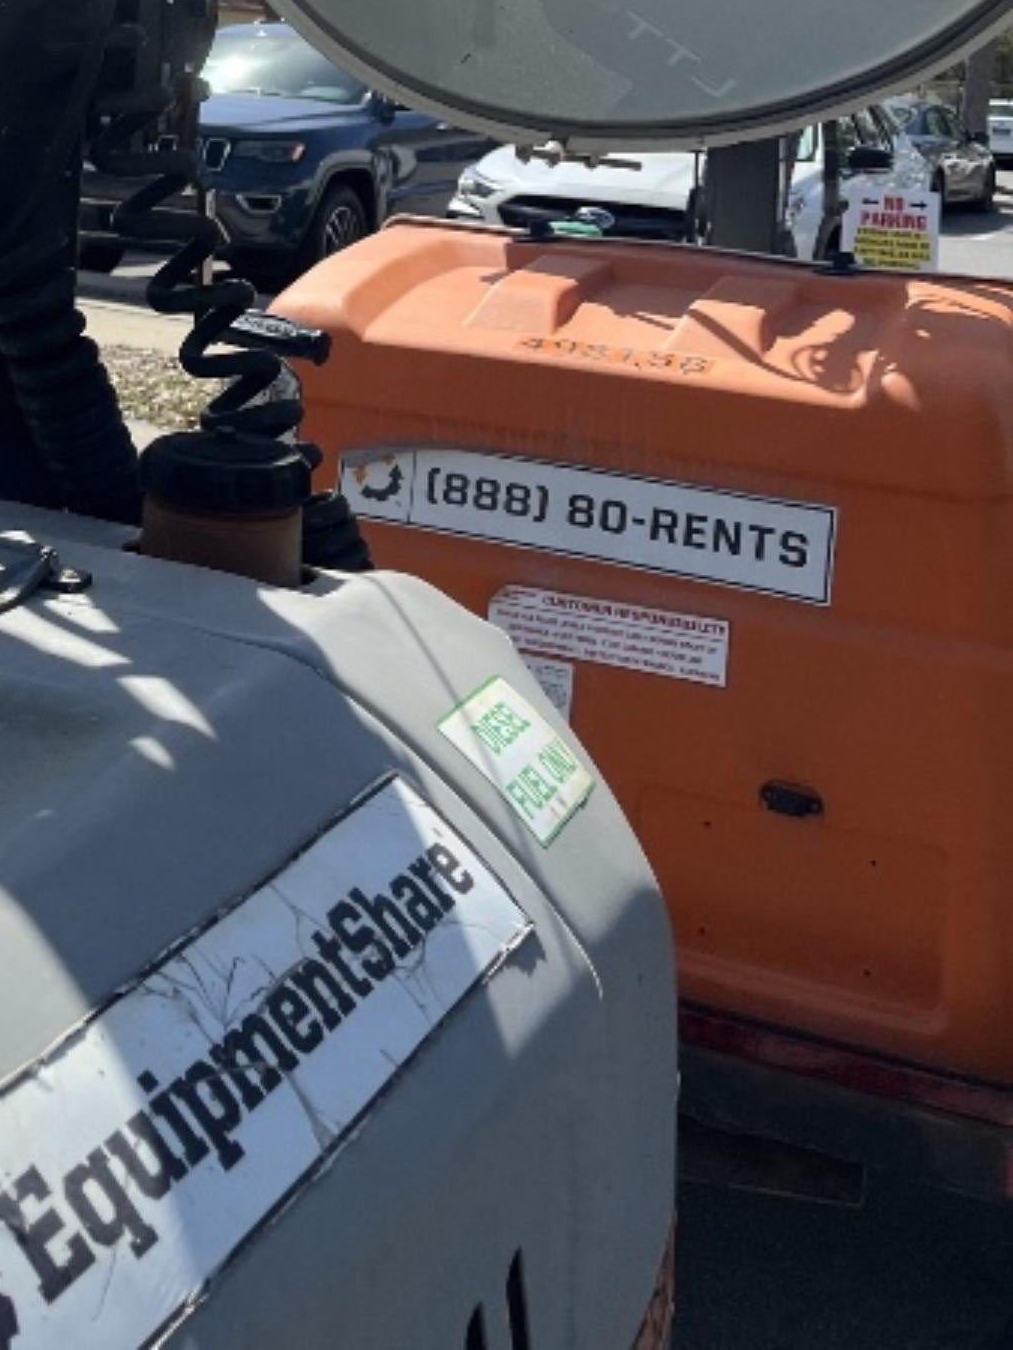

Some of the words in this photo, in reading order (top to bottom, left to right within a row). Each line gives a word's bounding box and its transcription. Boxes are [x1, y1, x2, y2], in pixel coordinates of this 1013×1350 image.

[859, 210, 928, 230] PARKING
[883, 196, 905, 212] NO
[427, 466, 550, 524] (888)
[566, 492, 810, 569] 80-RENTS
[470, 700, 531, 757] DIESEL
[505, 764, 558, 819] FUEL
[537, 737, 578, 785] ONLY
